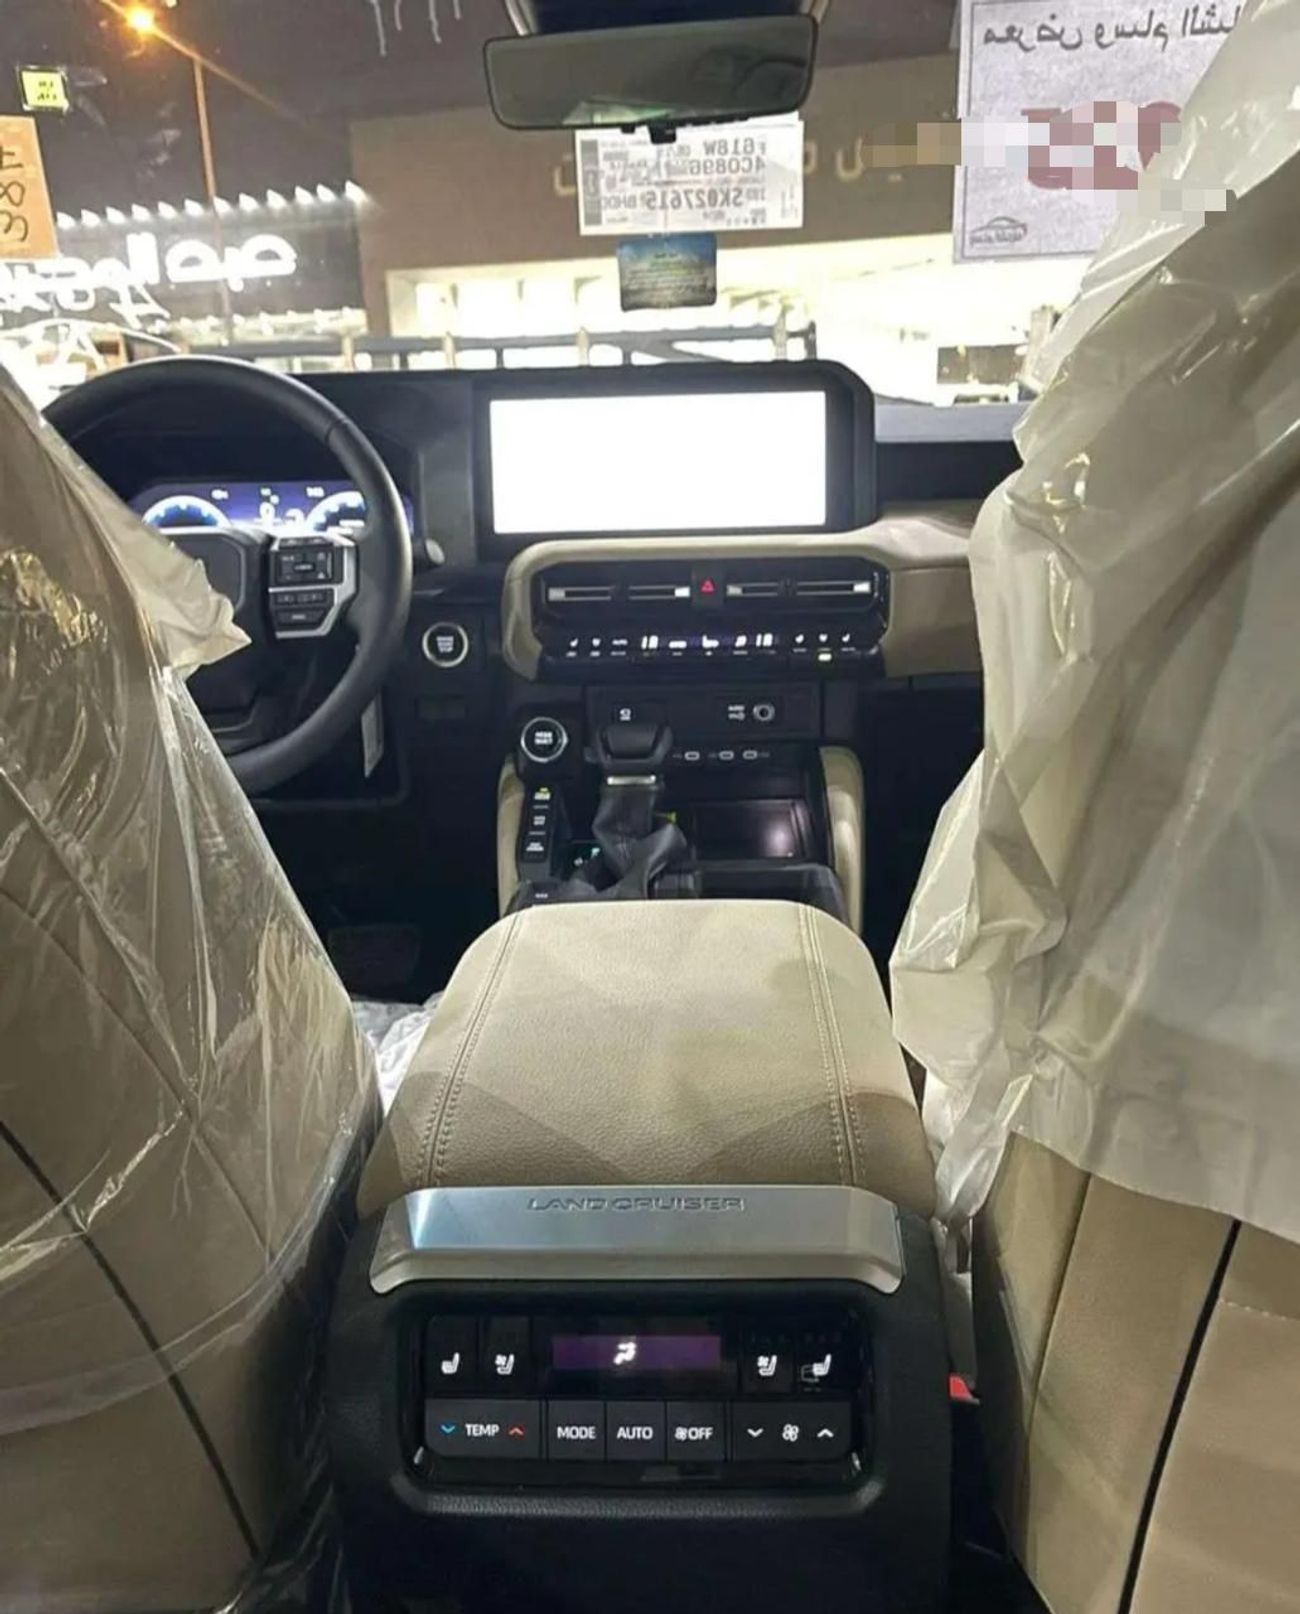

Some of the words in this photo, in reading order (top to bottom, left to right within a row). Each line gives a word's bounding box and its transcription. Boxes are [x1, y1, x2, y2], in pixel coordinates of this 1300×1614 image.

[527, 1197, 608, 1211] LAND
[611, 1196, 745, 1211] CRUISER
[465, 1424, 499, 1437] TEMP
[556, 1426, 597, 1439] MODE
[616, 1426, 654, 1440] AUTO
[688, 1427, 714, 1440] OFF
